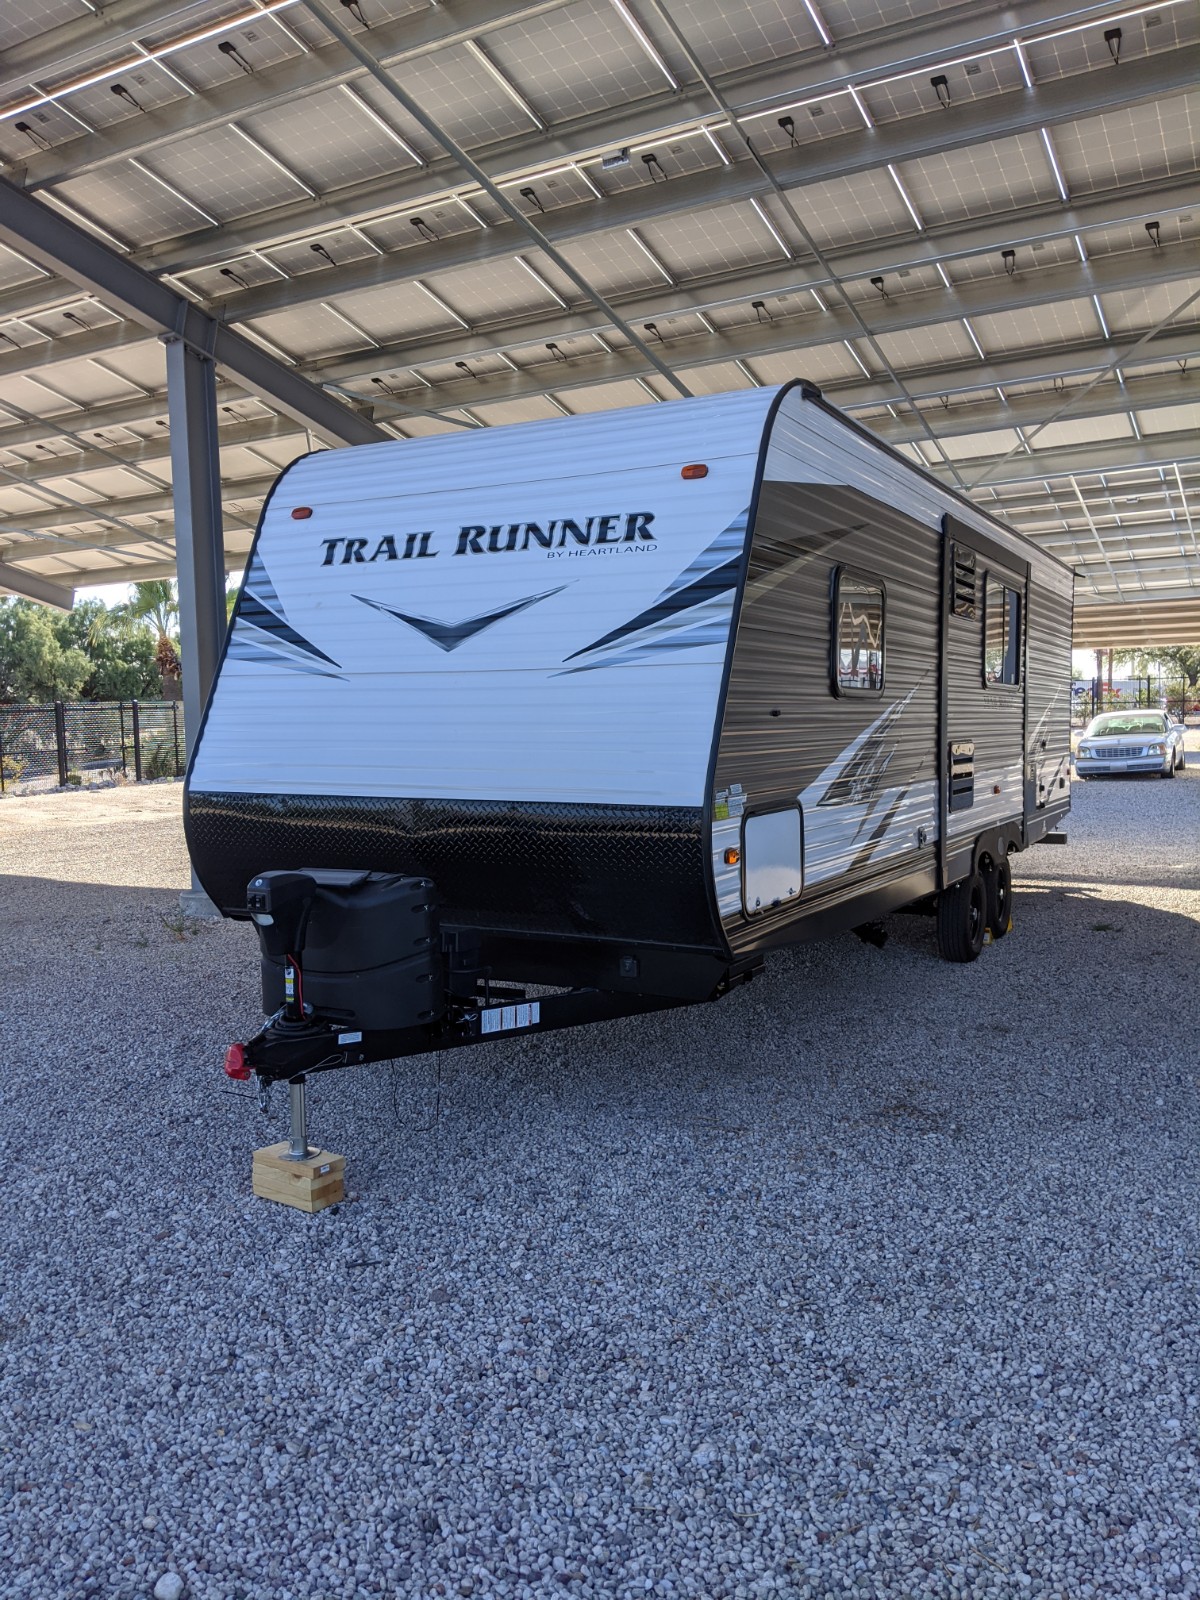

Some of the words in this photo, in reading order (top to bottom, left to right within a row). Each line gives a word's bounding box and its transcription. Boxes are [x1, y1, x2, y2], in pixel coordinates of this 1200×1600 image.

[319, 531, 440, 567] TRAIL
[452, 511, 658, 556] RUNNER
[547, 551, 564, 559] BY
[568, 544, 658, 558] HEARTLAND
